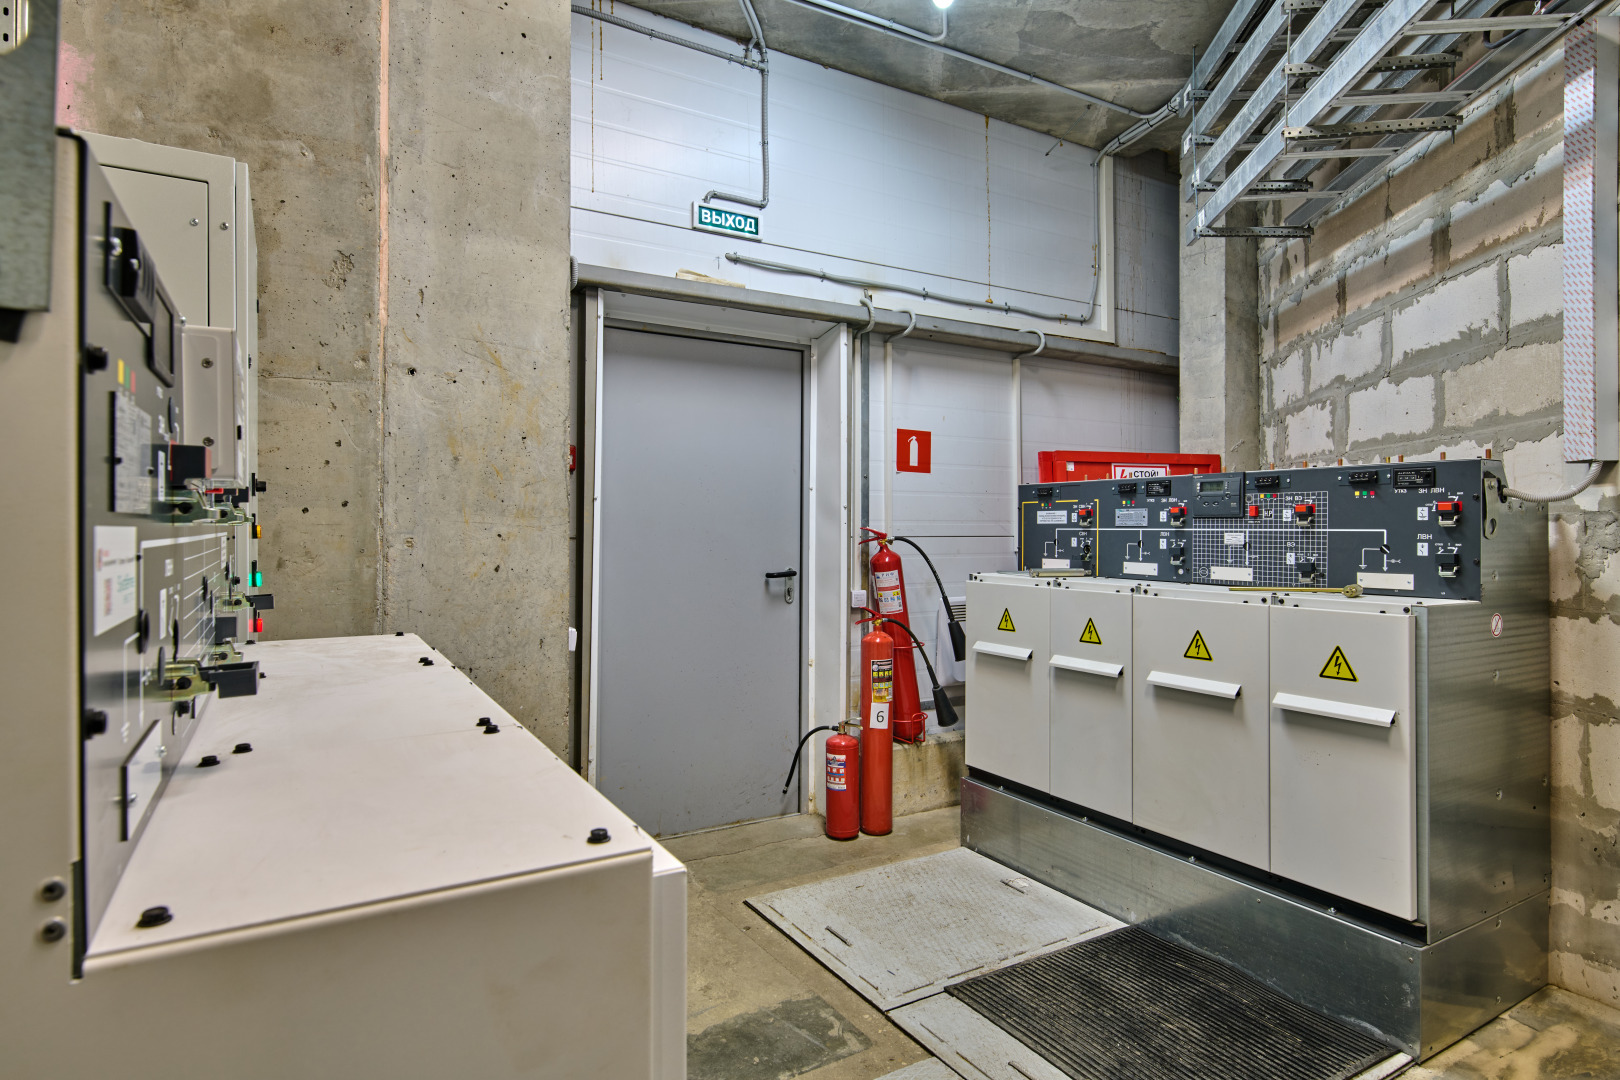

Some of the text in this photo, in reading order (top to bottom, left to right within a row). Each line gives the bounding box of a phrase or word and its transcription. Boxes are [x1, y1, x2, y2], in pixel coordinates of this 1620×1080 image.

[701, 208, 756, 233] ВЫХОД
[1133, 470, 1159, 478] СТОЙ!
[876, 710, 886, 723] 6
